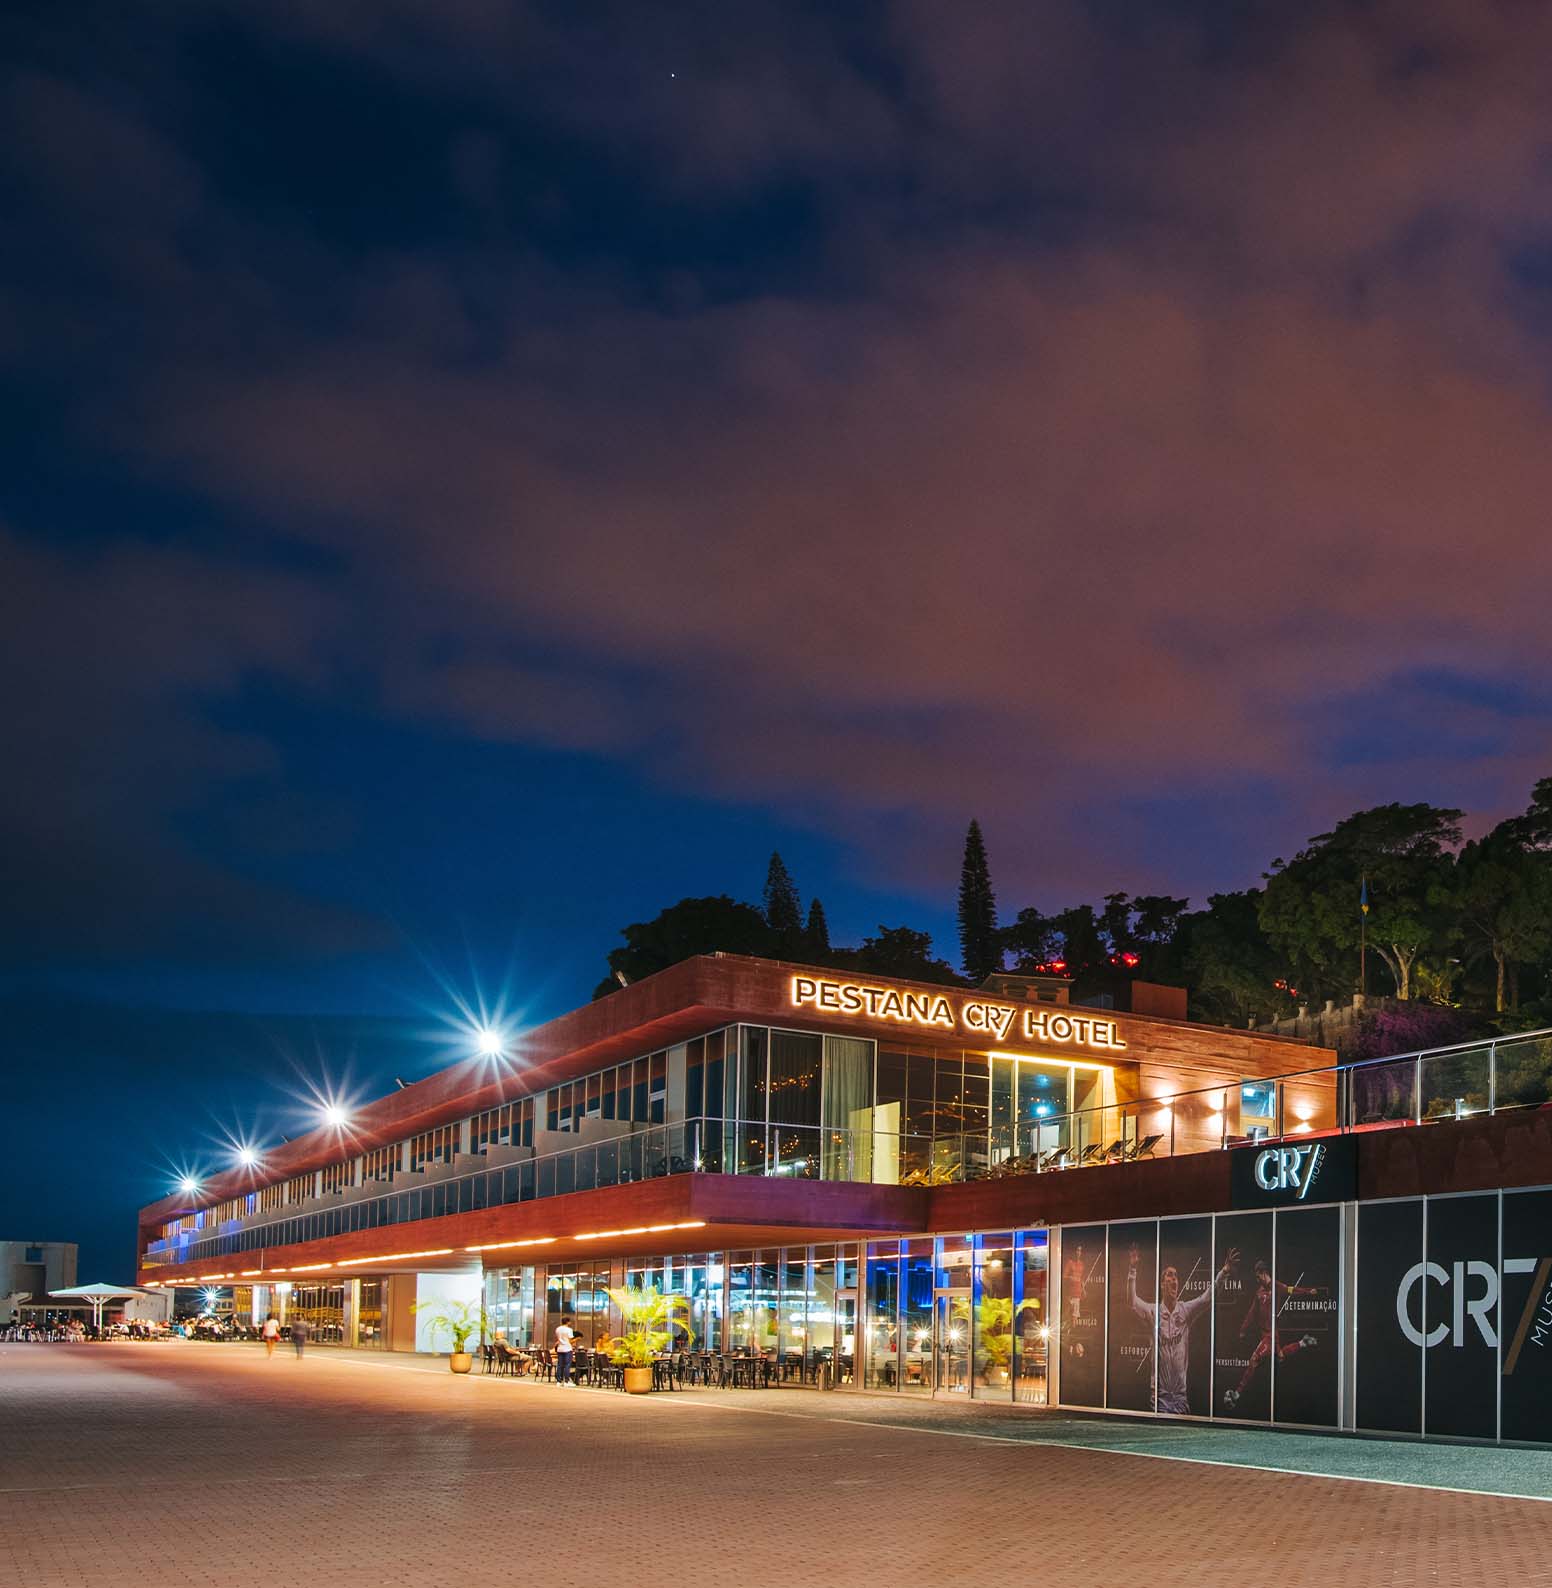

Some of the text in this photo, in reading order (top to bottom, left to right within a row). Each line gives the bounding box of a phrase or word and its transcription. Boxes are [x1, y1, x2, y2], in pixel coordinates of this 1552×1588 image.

[795, 977, 1127, 1047] PESTANA CR7 HOTEL
[1254, 1143, 1320, 1199] CR7
[1310, 1144, 1327, 1185] MUSEU
[1284, 1298, 1337, 1313] DETERMINAÇÃO
